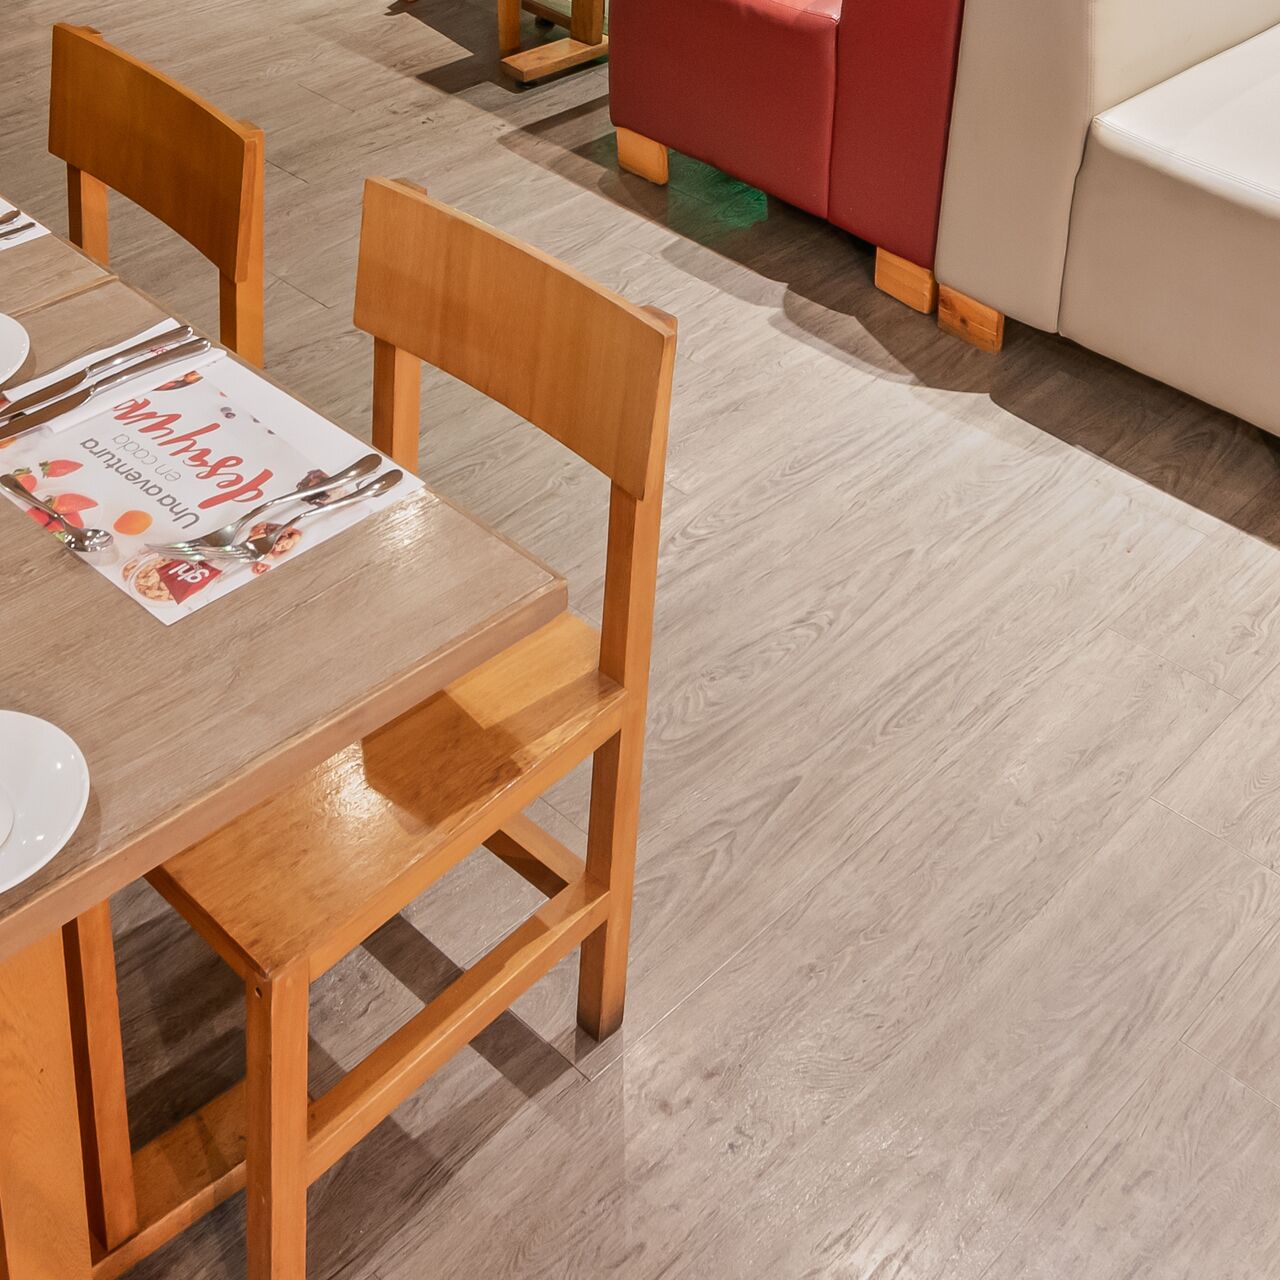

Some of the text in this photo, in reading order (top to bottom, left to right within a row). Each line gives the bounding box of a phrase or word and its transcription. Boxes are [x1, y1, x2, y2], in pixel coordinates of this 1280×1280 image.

[112, 432, 182, 483] en cada
[80, 437, 201, 530] Una aventura
[168, 562, 211, 585] ghl
